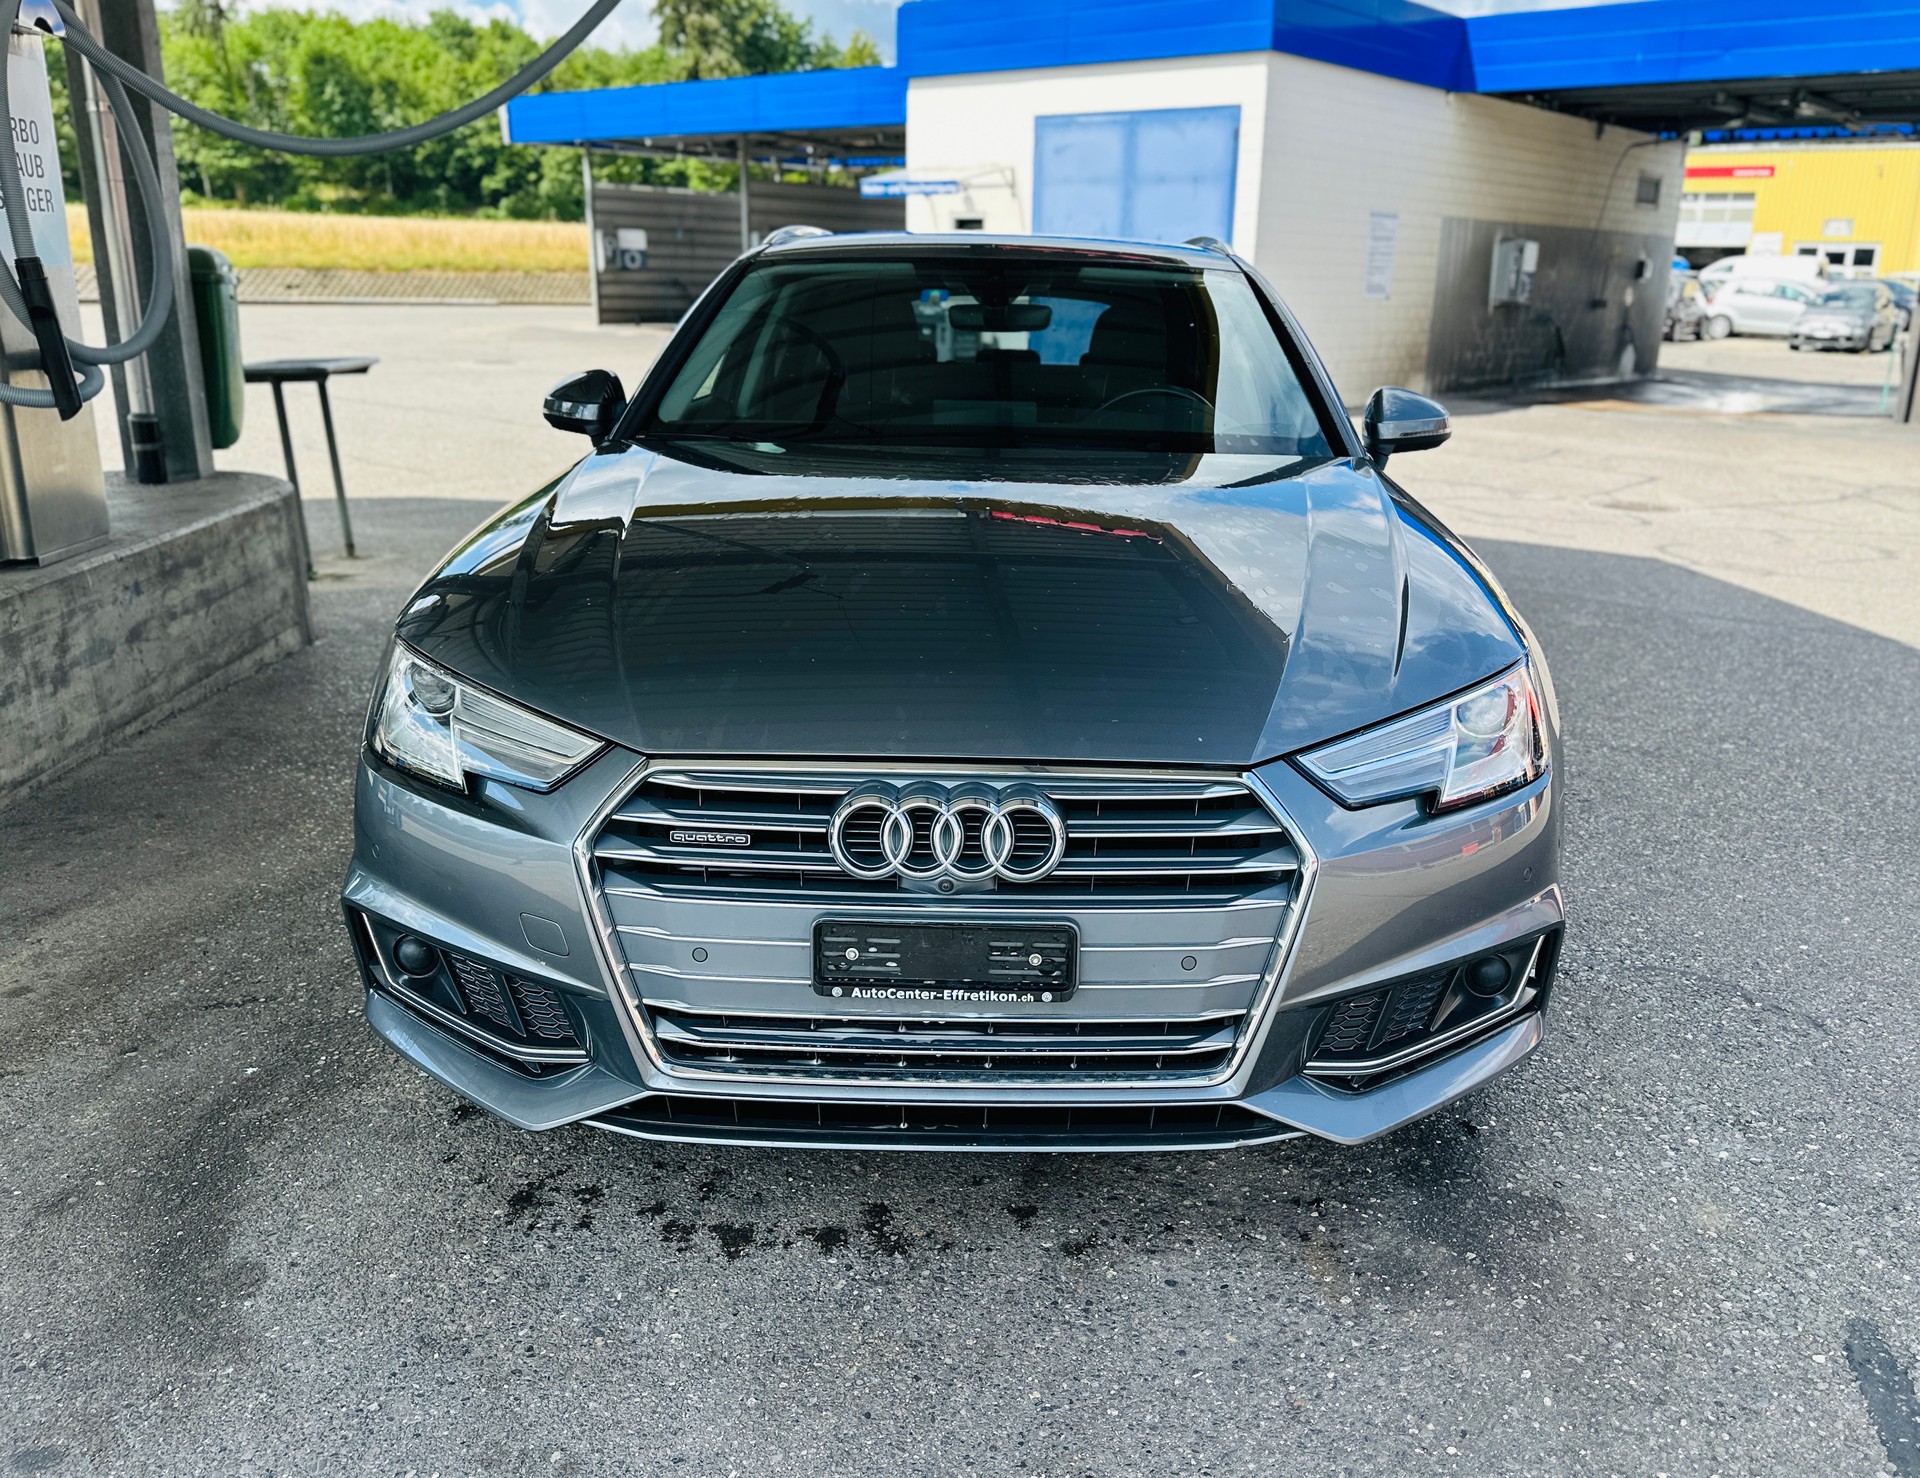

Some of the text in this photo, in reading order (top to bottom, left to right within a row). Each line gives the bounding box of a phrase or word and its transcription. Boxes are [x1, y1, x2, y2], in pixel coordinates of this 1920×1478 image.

[10, 117, 39, 144] RBO
[16, 152, 45, 178] AUB
[26, 187, 55, 213] GER
[673, 833, 747, 843] quattro
[851, 987, 1035, 1002] AutoCenter-Effretikon.ch
